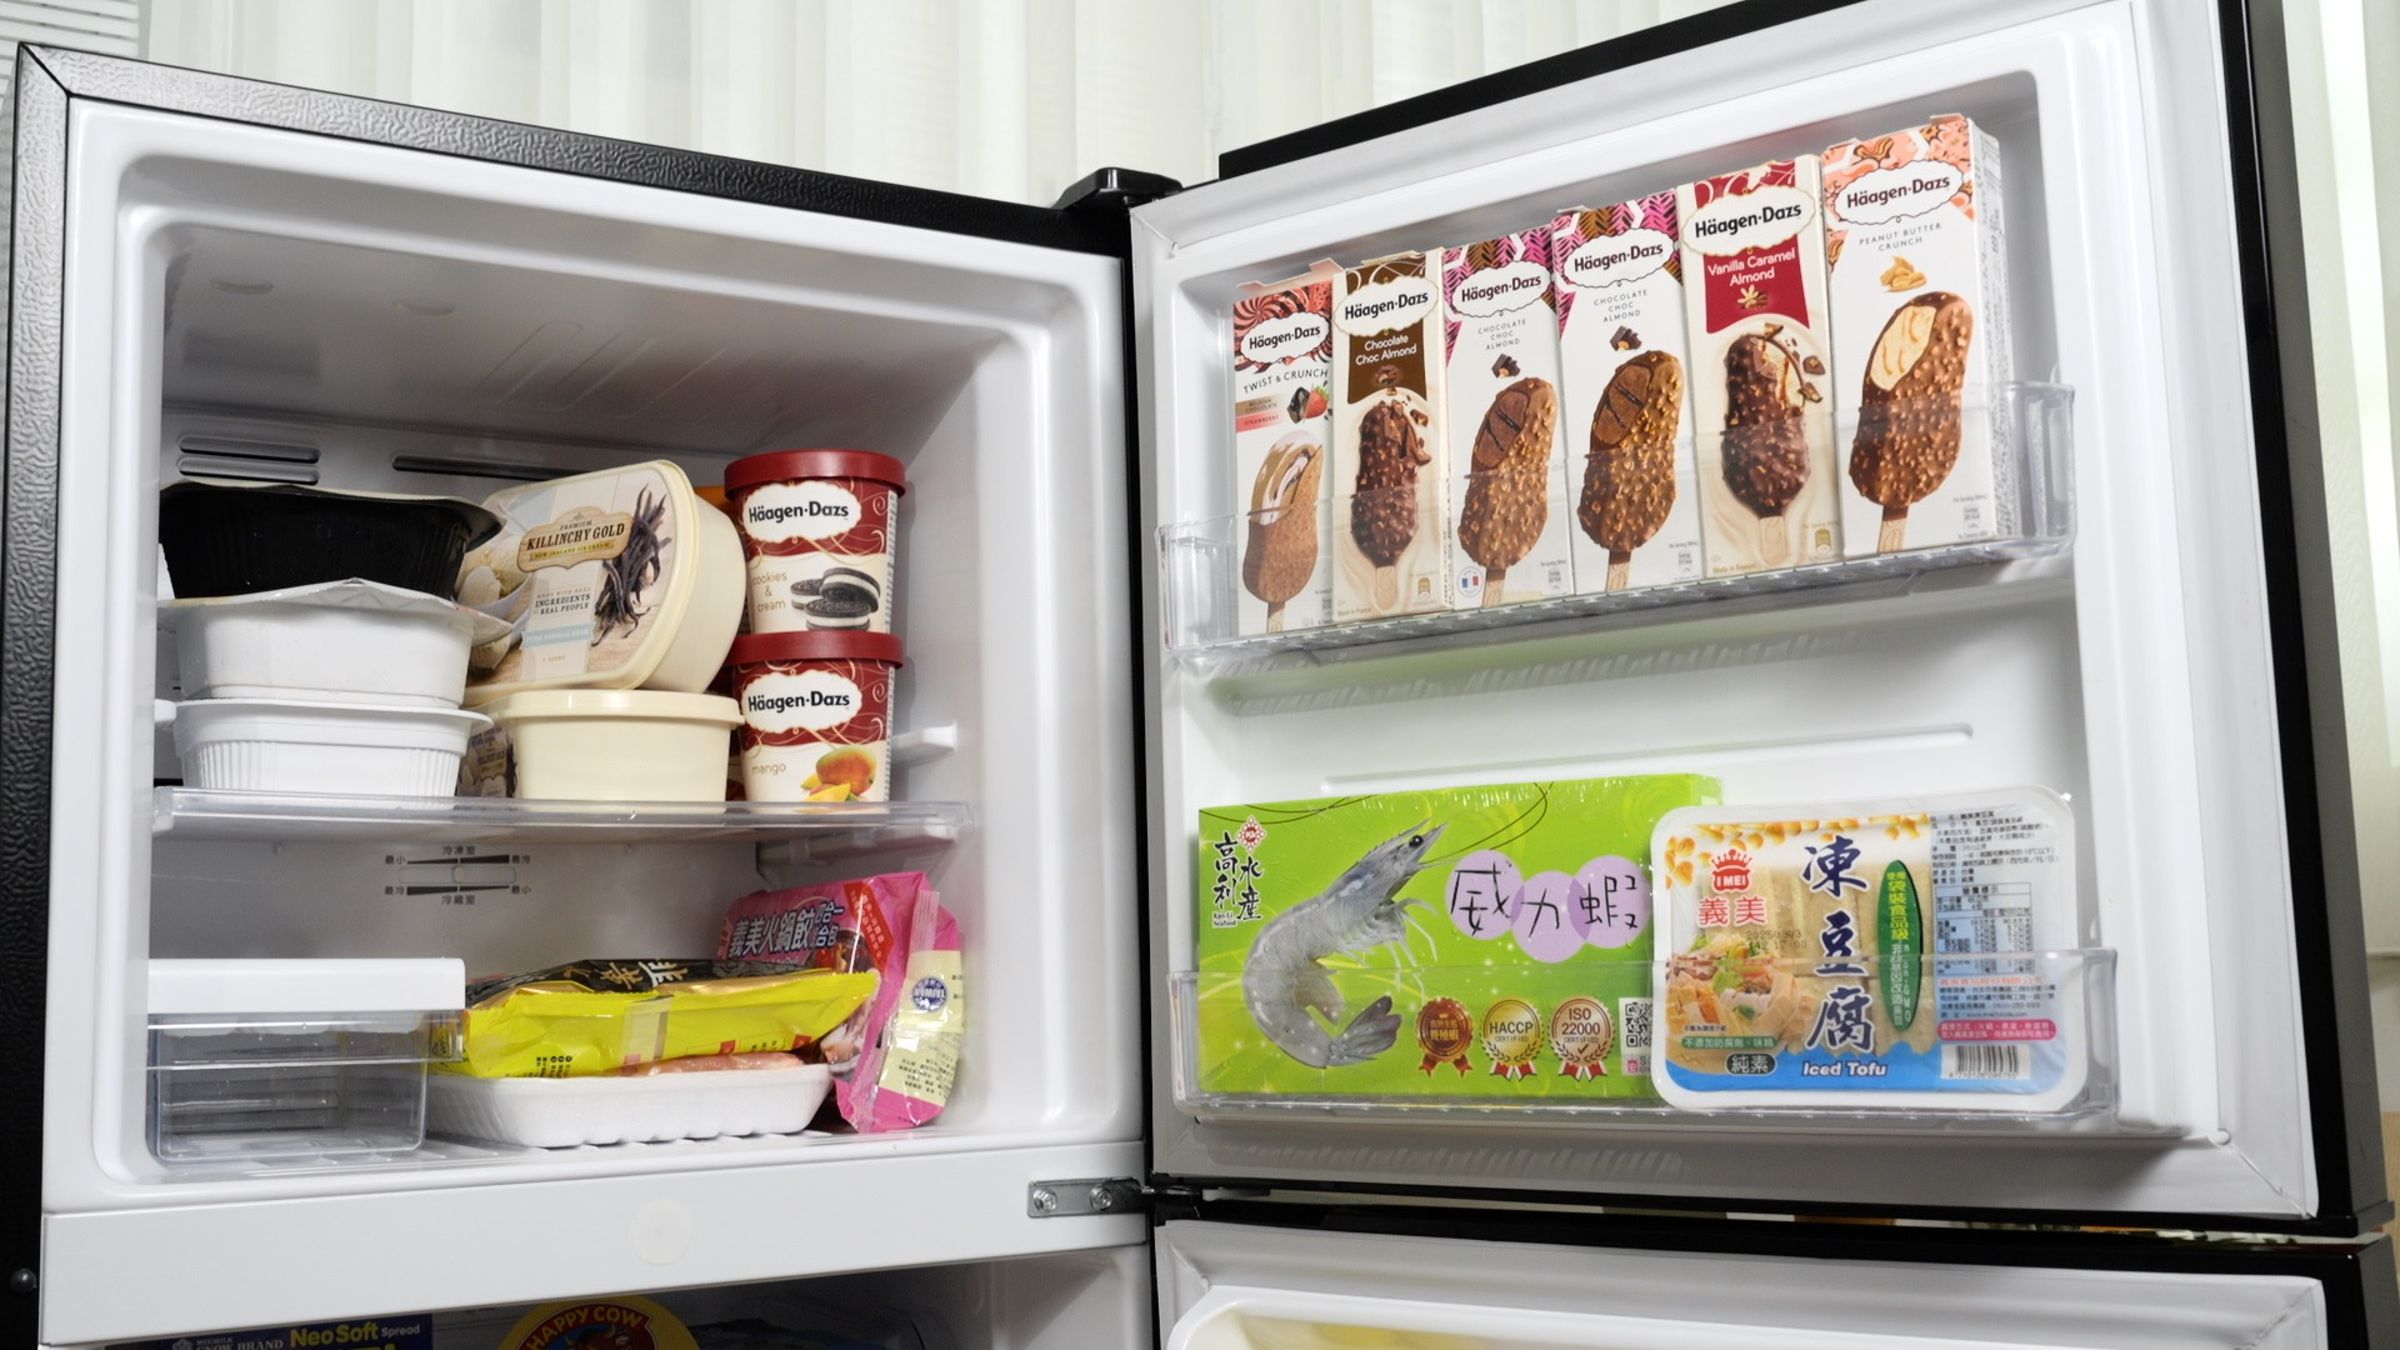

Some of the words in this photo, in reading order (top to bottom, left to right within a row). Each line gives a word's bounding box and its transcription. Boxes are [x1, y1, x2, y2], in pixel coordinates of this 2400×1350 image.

[1859, 231, 1899, 246] PEANUT
[1903, 223, 1941, 237] BUTTER
[1878, 237, 1923, 251] CRUNCH
[1707, 259, 1745, 276] Vanilla
[1747, 247, 1796, 268] Caramel
[1729, 267, 1775, 287] Almond
[1593, 289, 1647, 306] CHOCOLATE
[1608, 302, 1633, 312] CHOC
[1603, 309, 1641, 322] ALMOND
[1478, 318, 1527, 335] CHOCOLATE
[1364, 335, 1409, 351] Chocolate
[1490, 330, 1513, 341] CHOC
[1486, 338, 1520, 350] ALMOND
[1355, 354, 1380, 366] Choc
[1381, 344, 1417, 360] Almond
[1243, 376, 1272, 394] TWIST
[1275, 375, 1281, 383] &
[1283, 369, 1329, 381] CRUNCH
[526, 528, 591, 551] KILLINCHY
[593, 523, 625, 540] GOLD
[752, 572, 787, 585] cookies
[764, 588, 772, 597] &
[535, 594, 591, 608] INGREDIENTS
[560, 603, 589, 613] PEOPLE
[757, 601, 786, 613] cream
[752, 763, 787, 776] mango
[1450, 862, 1638, 938] 威力蝦
[1698, 896, 1766, 925] 義美
[1802, 835, 1873, 1050] 凍豆腐
[1568, 1008, 1591, 1021] ISO
[1489, 1021, 1533, 1035] HACCP
[1562, 1022, 1600, 1035] 22000
[1731, 1055, 1769, 1074] 純素
[1803, 1062, 1842, 1077] Iced
[1847, 1062, 1887, 1077] Tofu
[381, 1324, 421, 1339] Spread
[526, 1308, 589, 1350] HAPPY
[594, 1306, 642, 1328] COW
